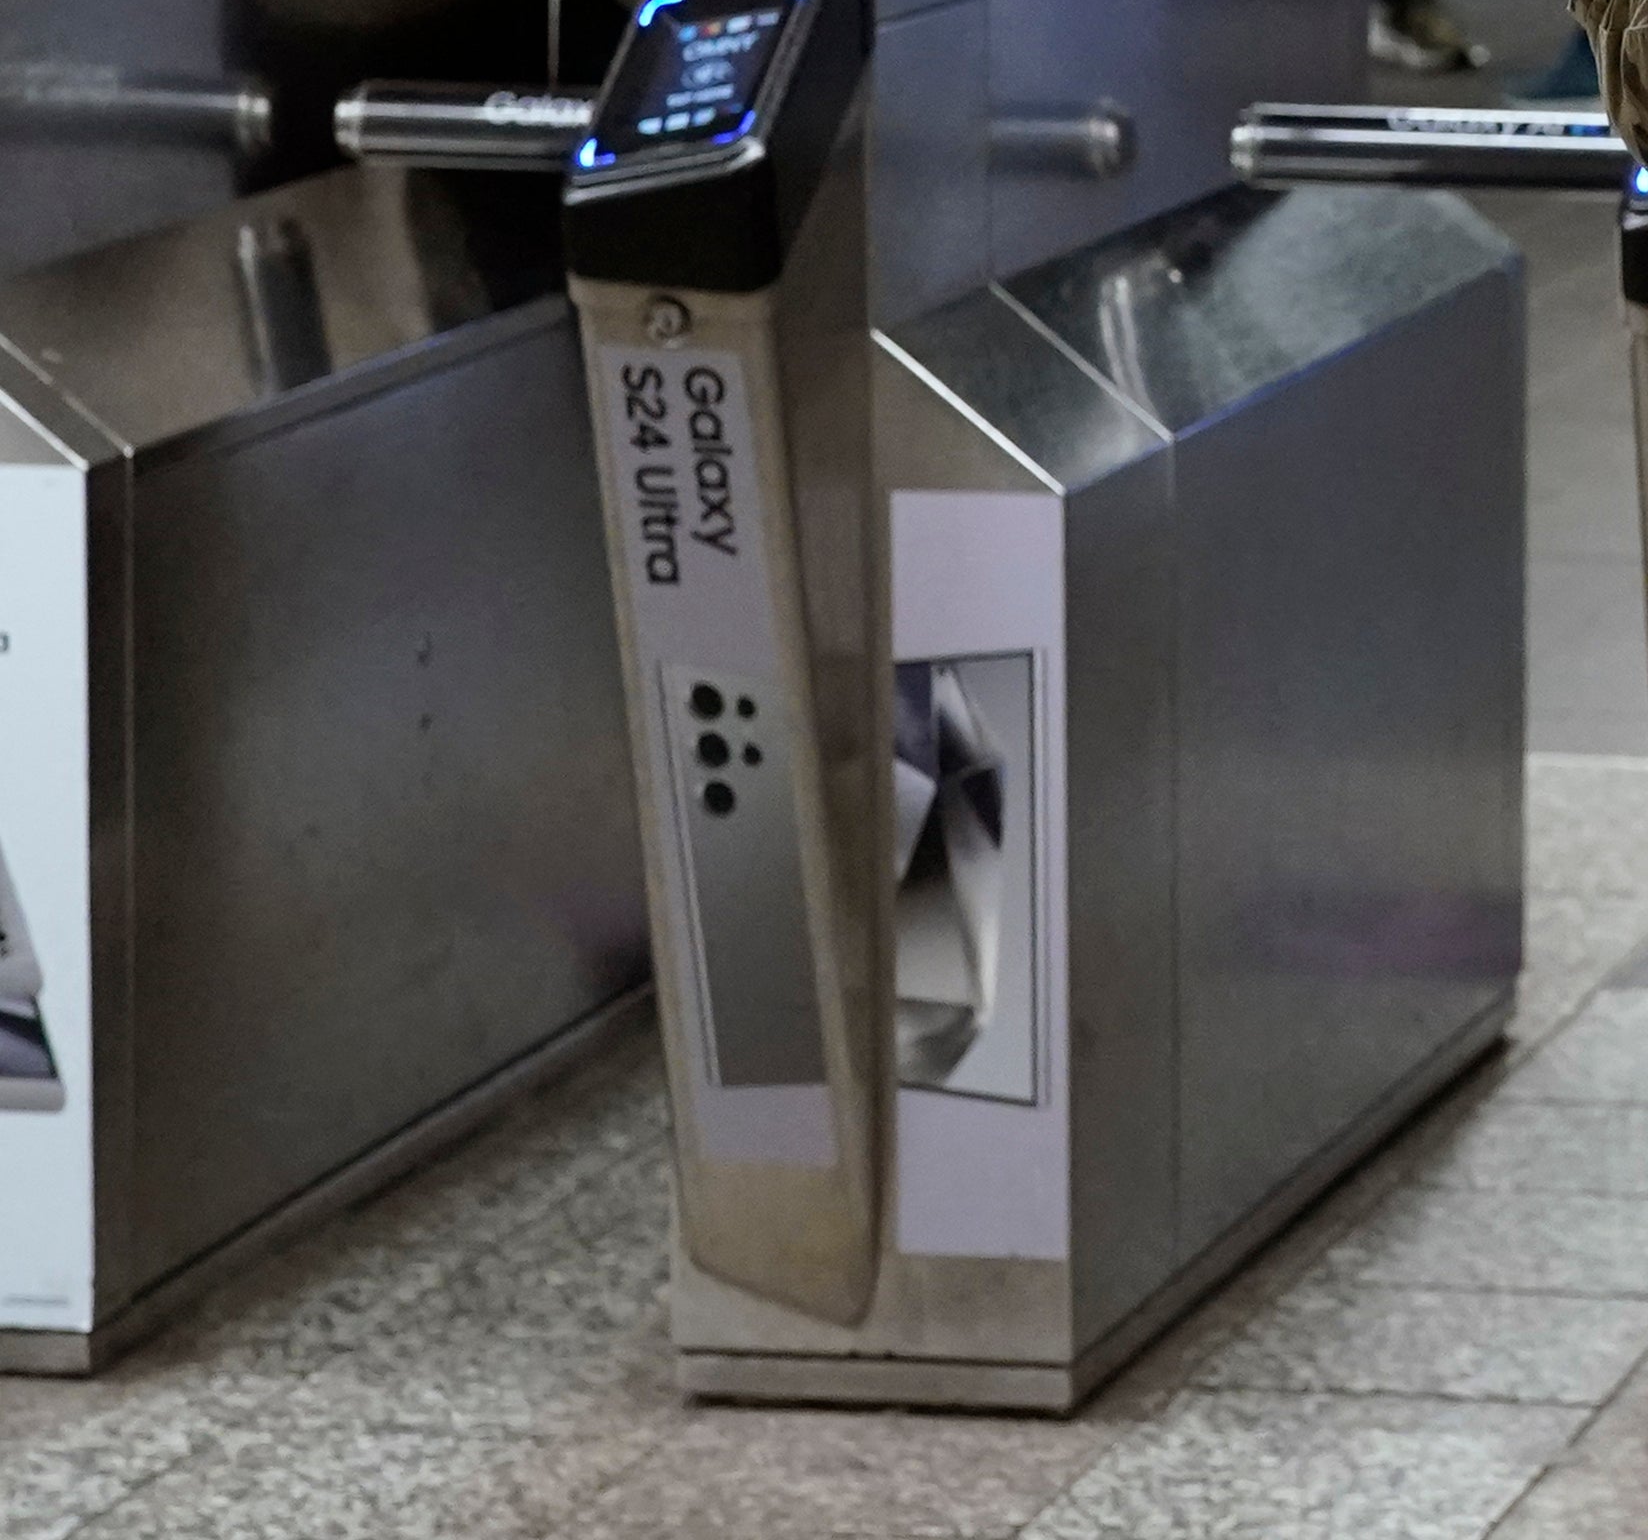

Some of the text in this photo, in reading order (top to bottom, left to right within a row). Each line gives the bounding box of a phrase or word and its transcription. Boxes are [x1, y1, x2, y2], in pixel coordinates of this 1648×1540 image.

[621, 363, 680, 585] S24 Ultra
[683, 365, 739, 556] Galaxy
